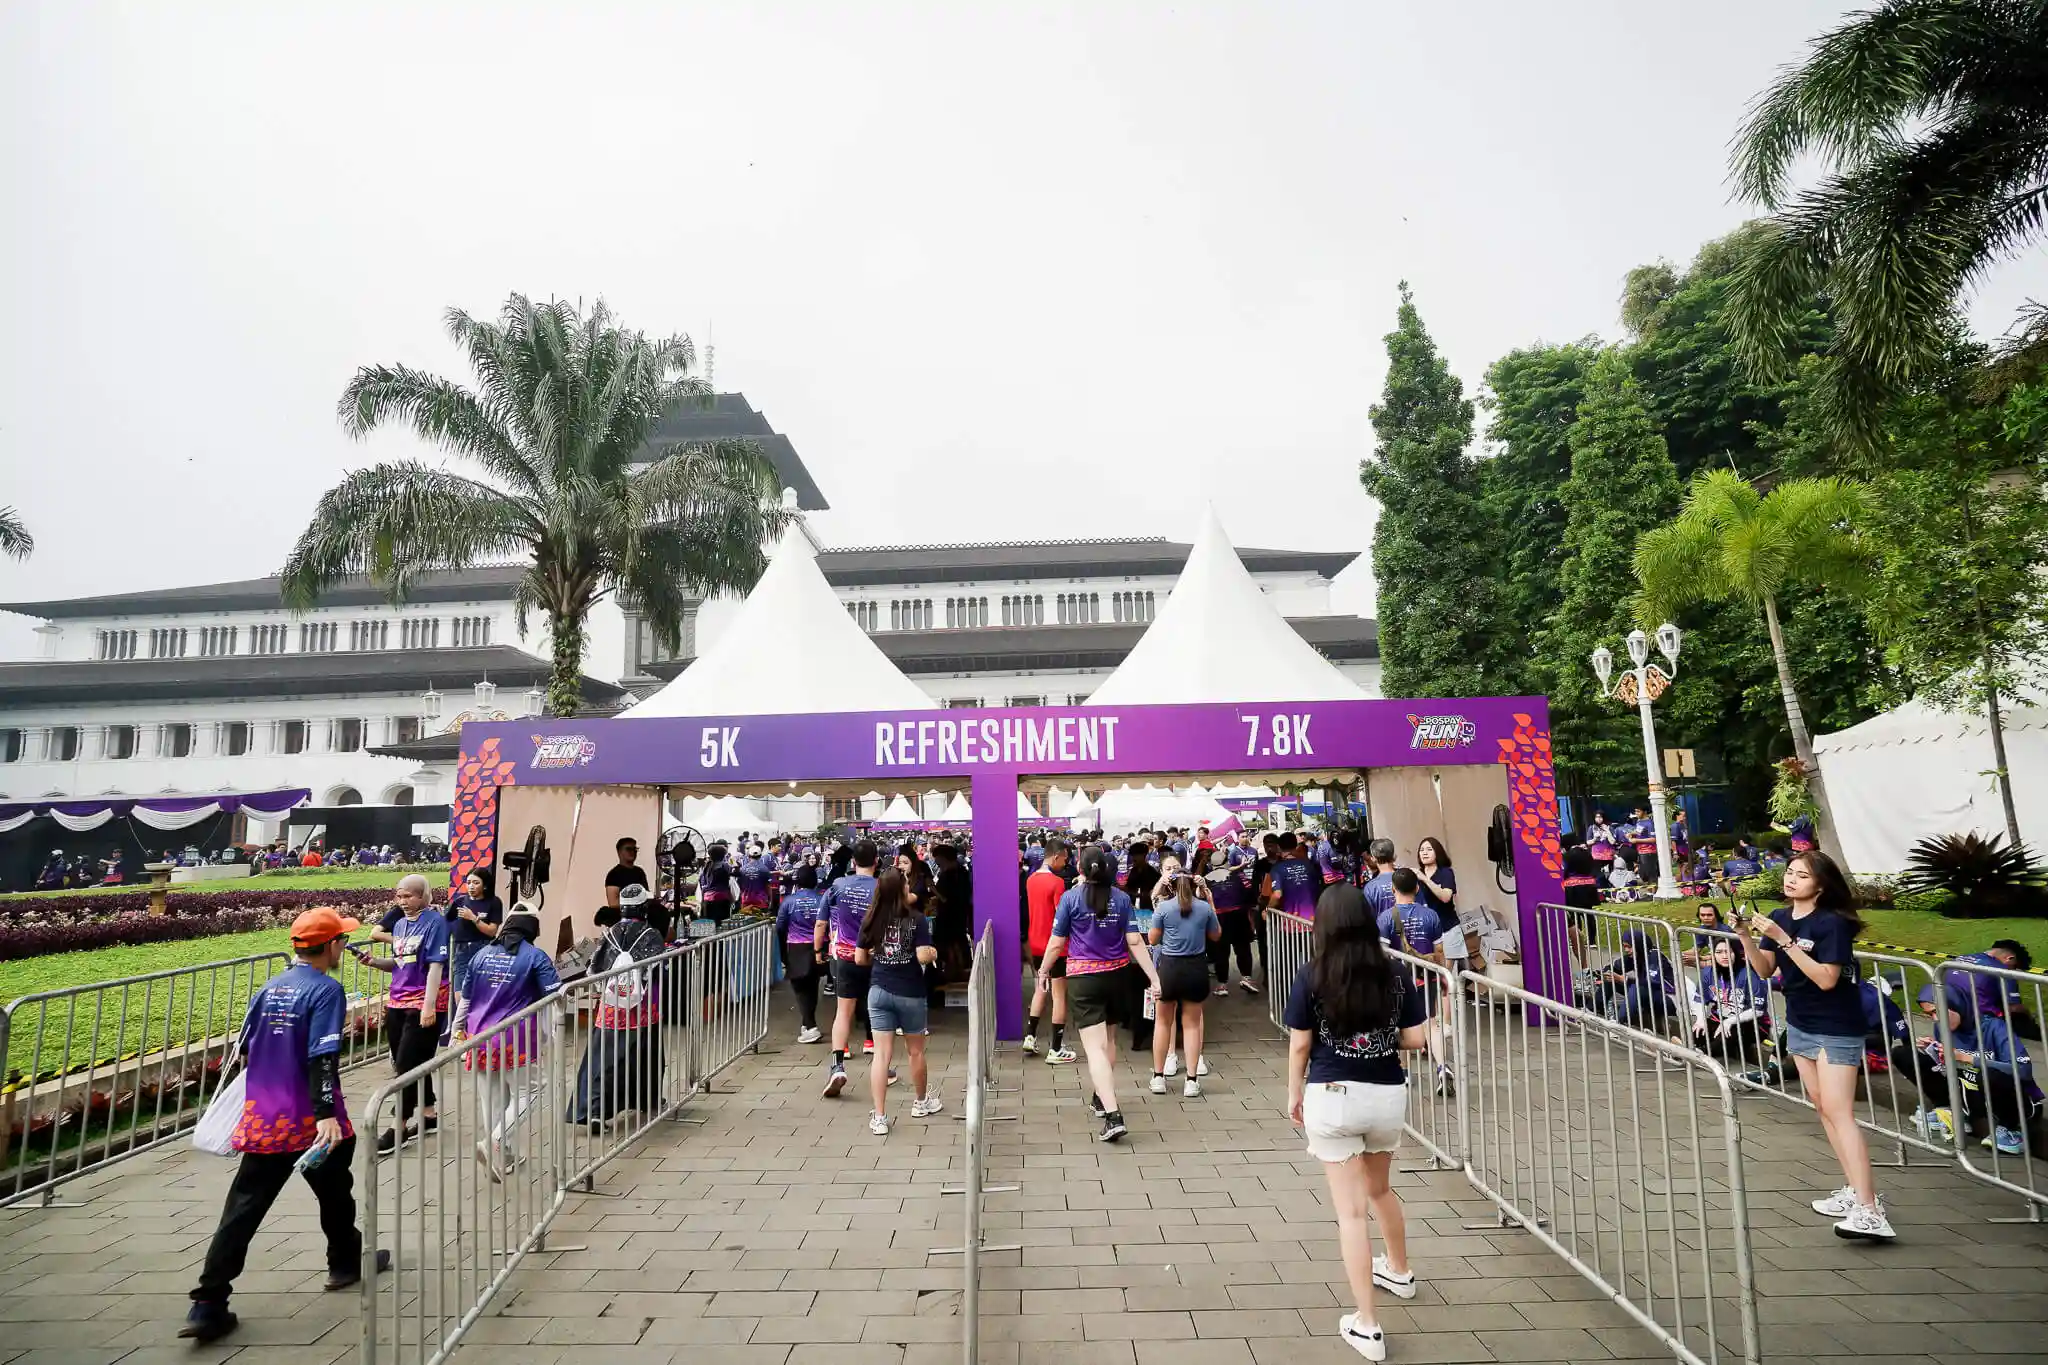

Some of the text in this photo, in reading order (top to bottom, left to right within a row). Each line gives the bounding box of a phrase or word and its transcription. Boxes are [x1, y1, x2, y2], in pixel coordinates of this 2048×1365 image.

[1425, 716, 1461, 725] POSPAY
[548, 736, 582, 744] POSPAY
[875, 716, 1119, 766] REFRESHMENT
[1241, 714, 1314, 756] 7.8K
[1411, 724, 1459, 748] RUN
[1422, 738, 1456, 747] 2024
[531, 744, 578, 767] RUN
[700, 727, 741, 768] 5K
